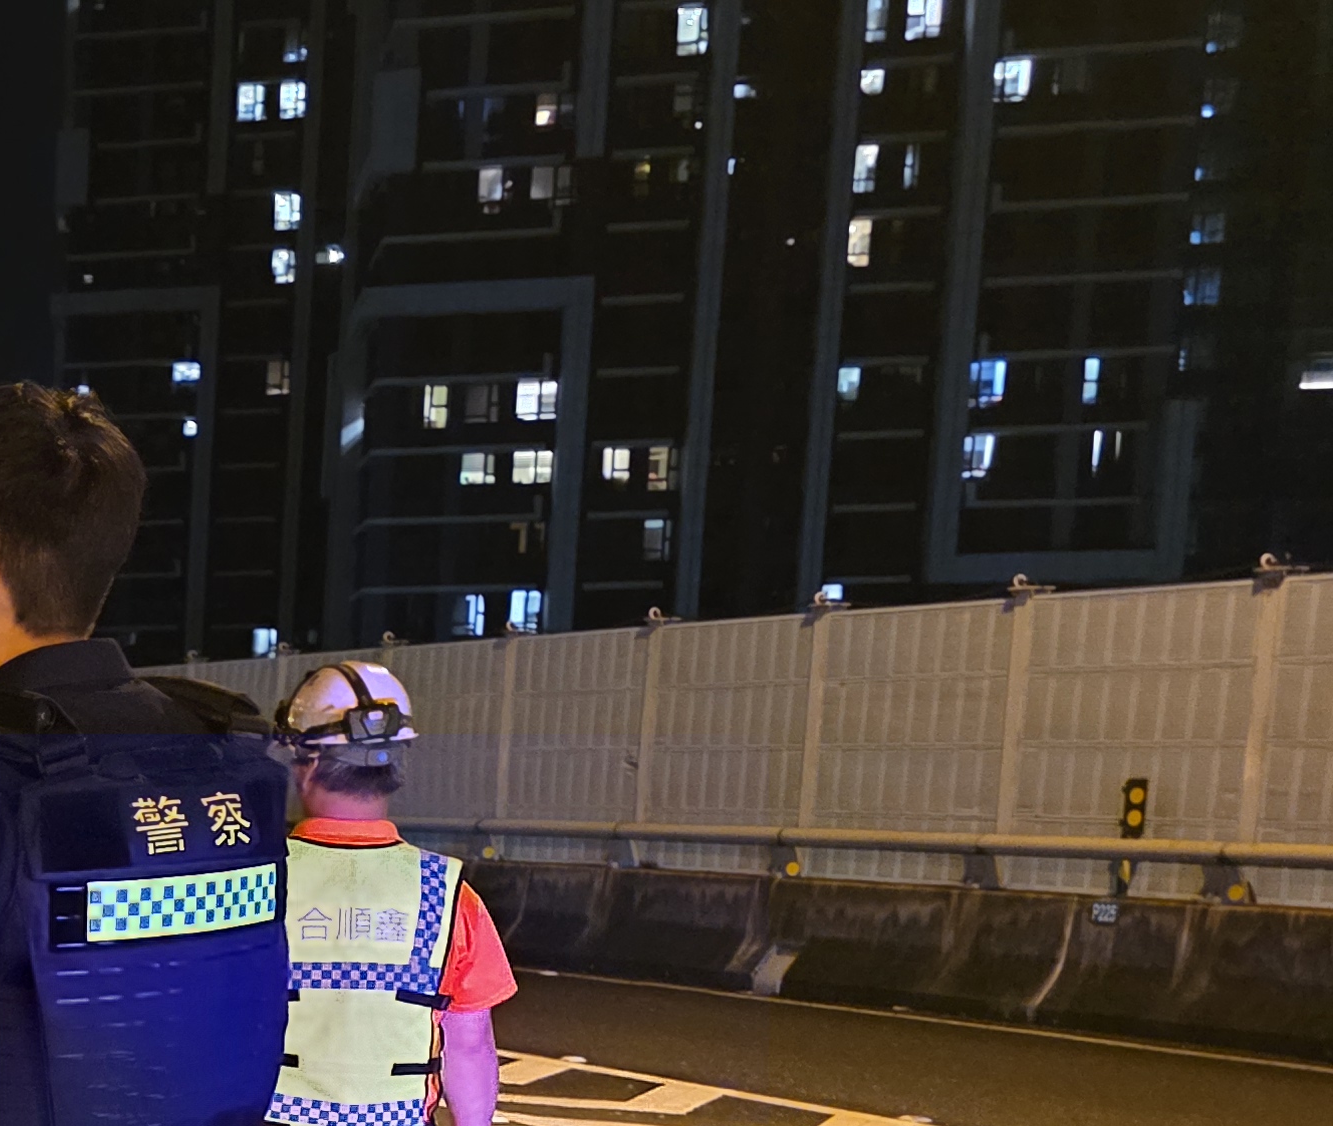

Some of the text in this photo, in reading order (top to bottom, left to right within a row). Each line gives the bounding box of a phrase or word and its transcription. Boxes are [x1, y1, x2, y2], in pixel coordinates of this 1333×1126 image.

[131, 791, 252, 855] 警察
[297, 906, 409, 942] 合順鑫
